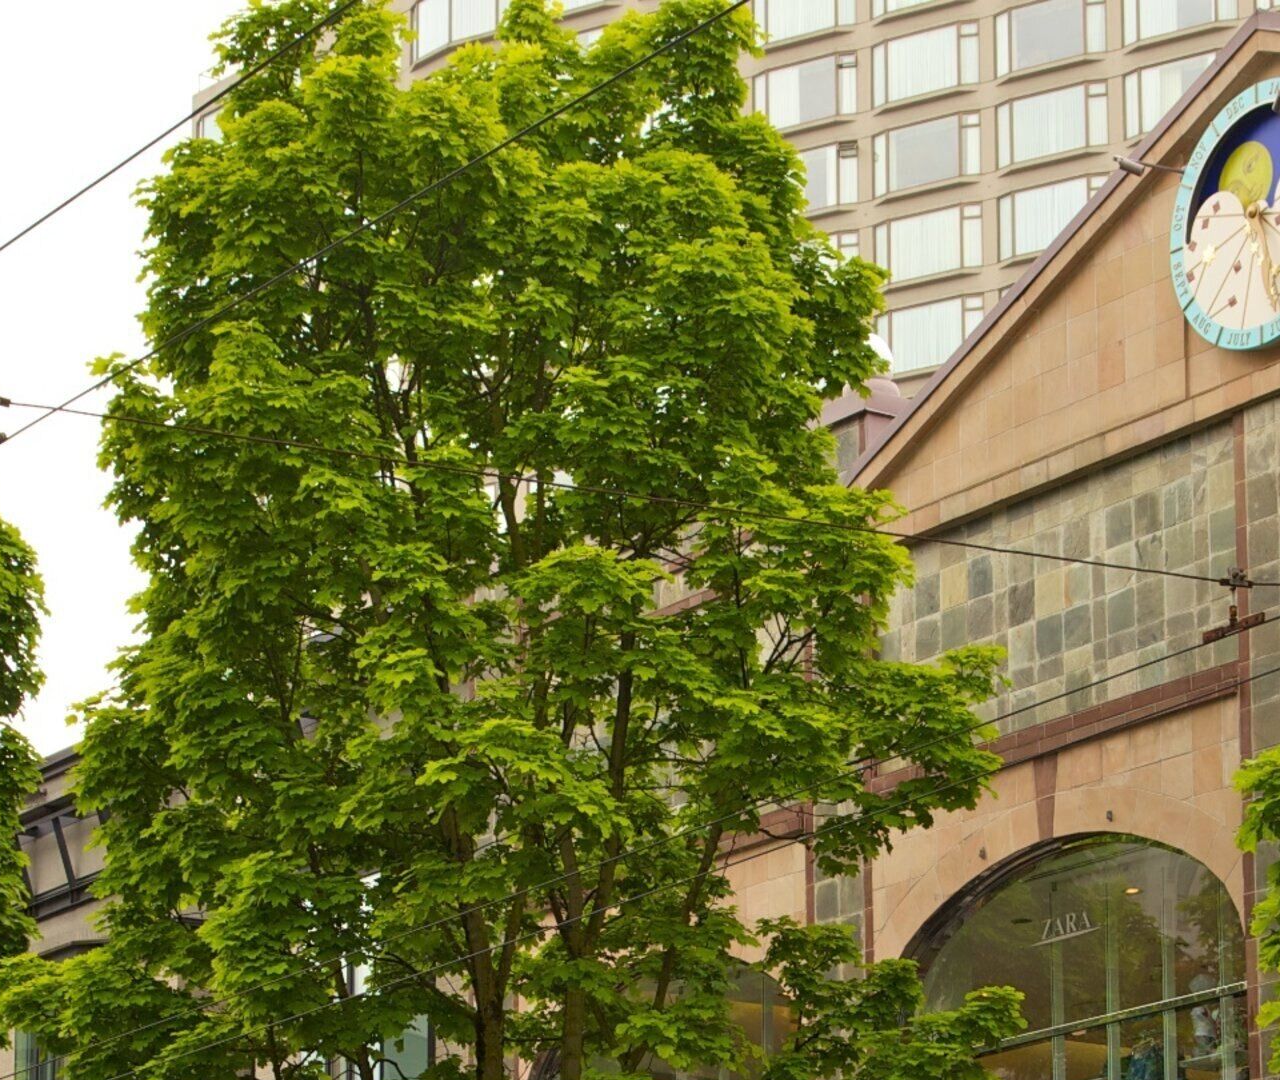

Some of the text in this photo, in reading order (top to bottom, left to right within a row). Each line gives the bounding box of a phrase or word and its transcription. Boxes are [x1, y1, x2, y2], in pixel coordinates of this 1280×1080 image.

[1226, 97, 1245, 119] DEC
[1190, 143, 1208, 170] NOV
[1173, 205, 1185, 232] OCT
[1173, 261, 1189, 298] SEPT
[1192, 313, 1211, 335] AUG
[1226, 331, 1253, 345] JULY
[1040, 910, 1092, 940] ZARA
